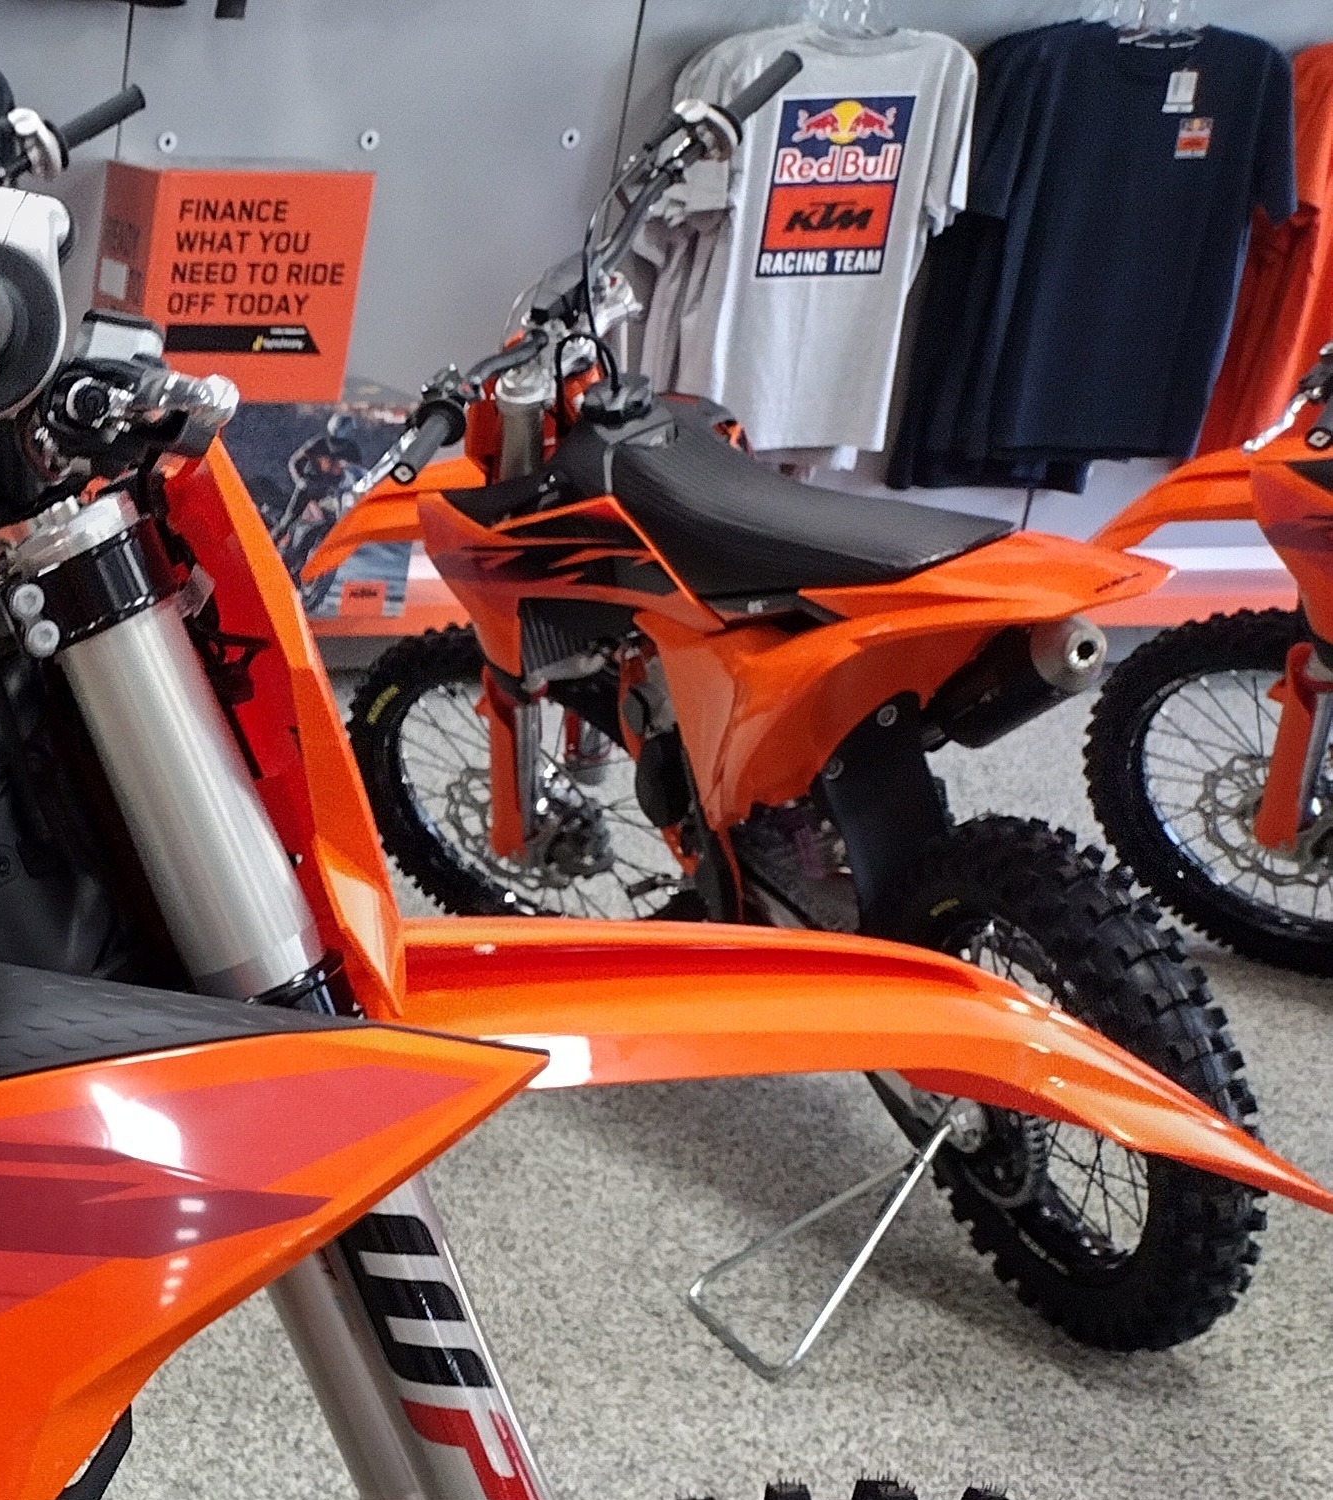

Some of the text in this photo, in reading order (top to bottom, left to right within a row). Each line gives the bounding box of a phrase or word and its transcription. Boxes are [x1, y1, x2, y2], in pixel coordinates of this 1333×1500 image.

[776, 145, 901, 182] Red Bull
[178, 199, 289, 223] FINANCE
[785, 201, 874, 232] KTM
[176, 230, 311, 255] WHAT YOU
[171, 261, 345, 286] NEED TO RIDE
[759, 249, 882, 275] RACING TEAM
[167, 291, 310, 316] OFF TODAY
